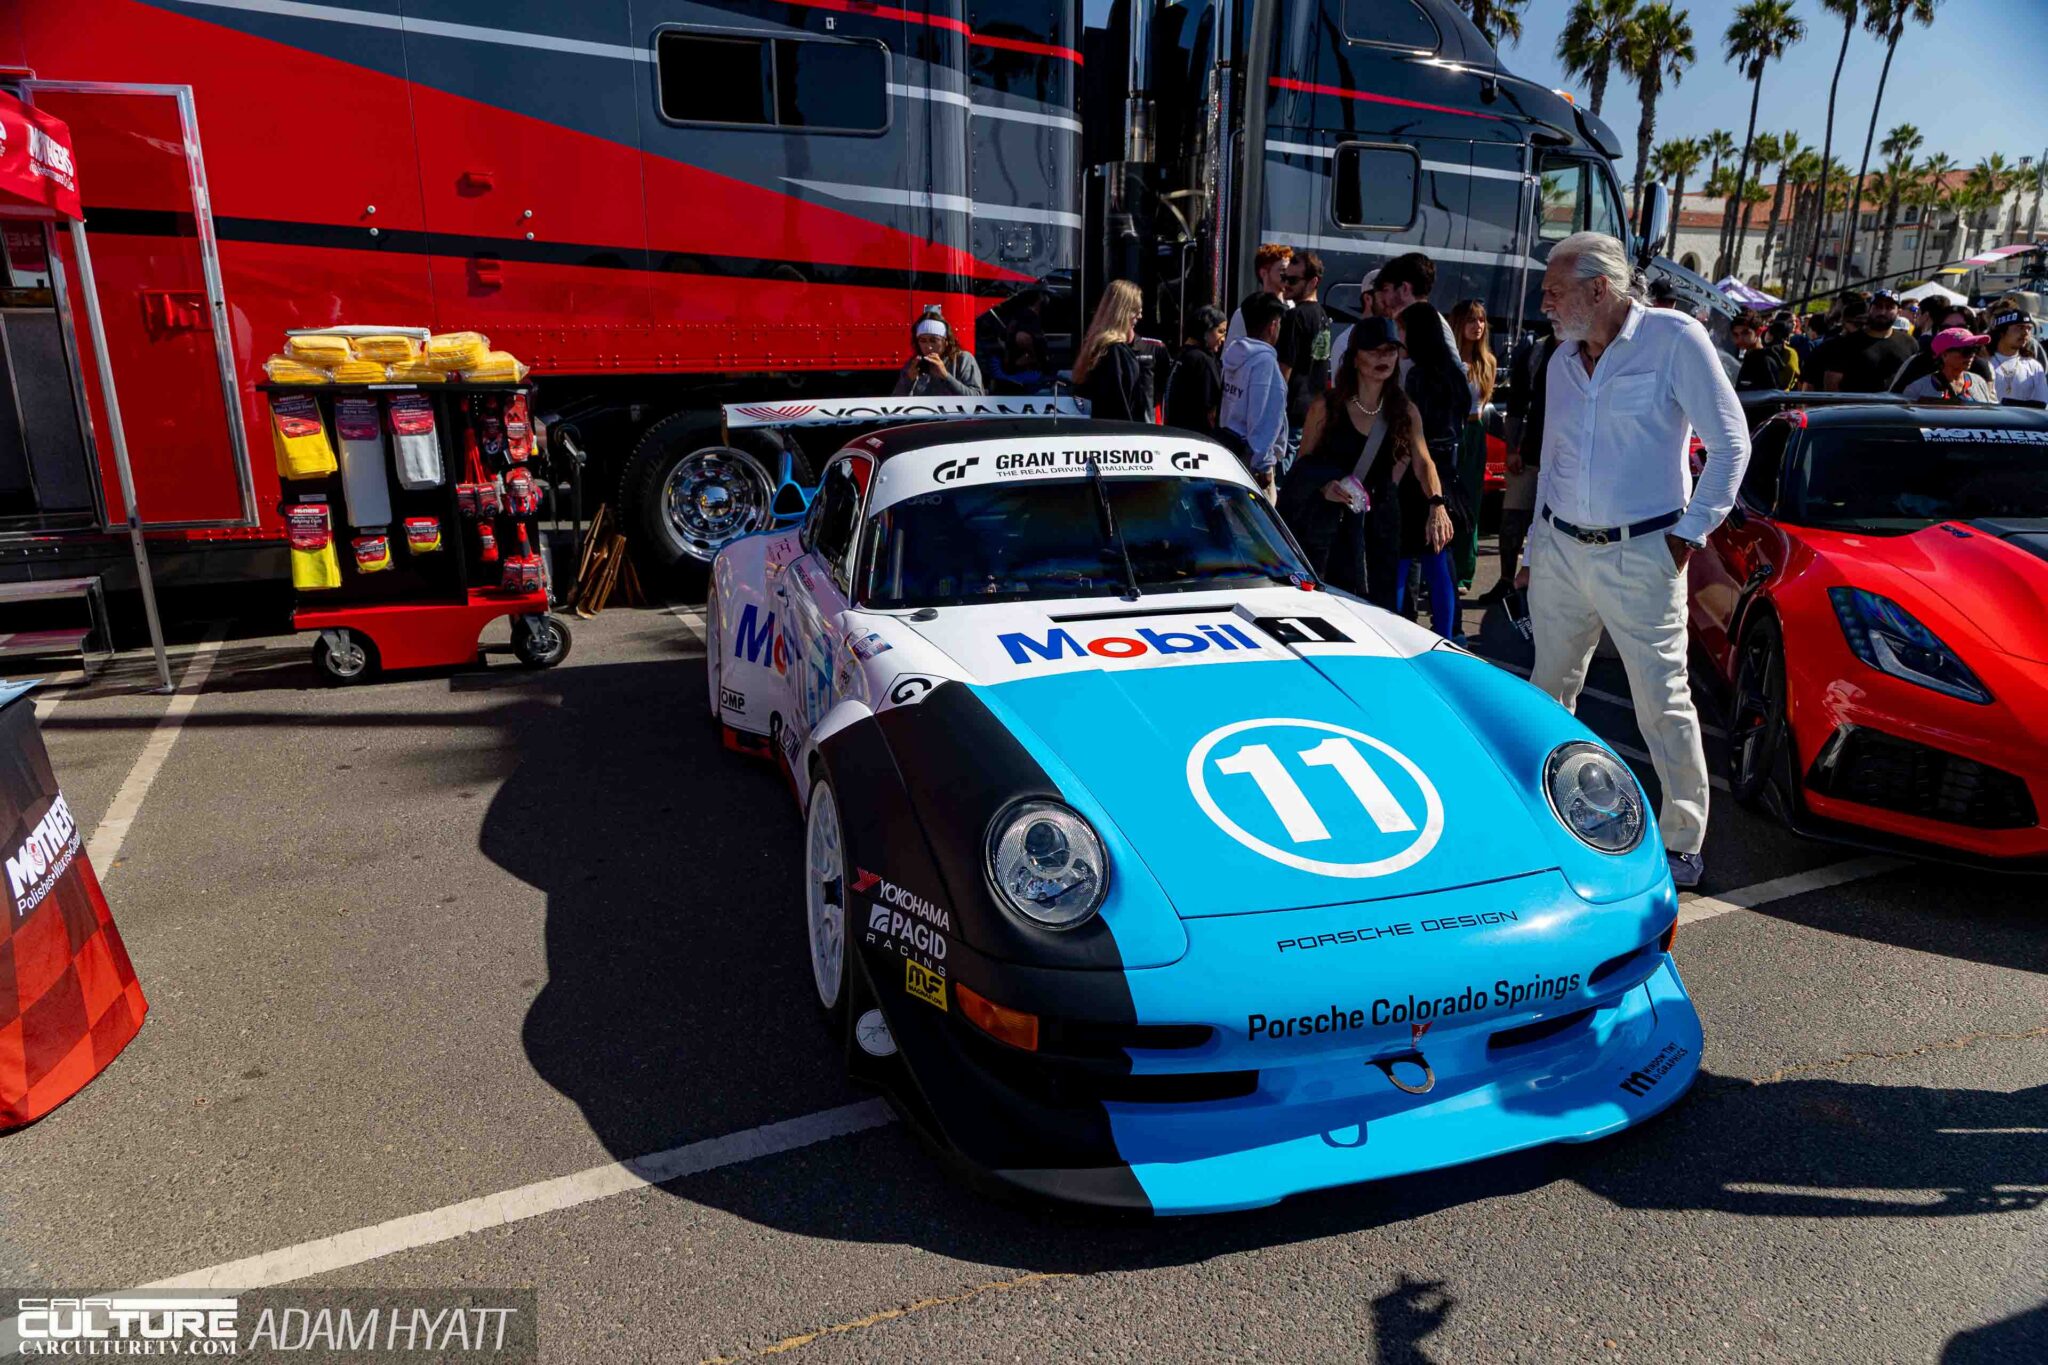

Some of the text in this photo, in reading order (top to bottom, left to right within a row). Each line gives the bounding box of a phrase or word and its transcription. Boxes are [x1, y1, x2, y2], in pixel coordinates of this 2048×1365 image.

[1920, 427, 2048, 441] MOTHER
[996, 451, 1055, 469] GRAN
[1020, 468, 1048, 476] REAL
[1050, 466, 1092, 474] DRIVING
[997, 617, 1327, 665] Mobil 1
[721, 690, 746, 710] OMP
[1214, 737, 1418, 843] 11
[879, 879, 950, 932] YOKOHAMA
[891, 911, 947, 960] PAGID
[1277, 910, 1519, 953] PORSCHE DESIGN
[866, 932, 946, 977] RACING
[1248, 973, 1580, 1042] Porsche Colorado Springs
